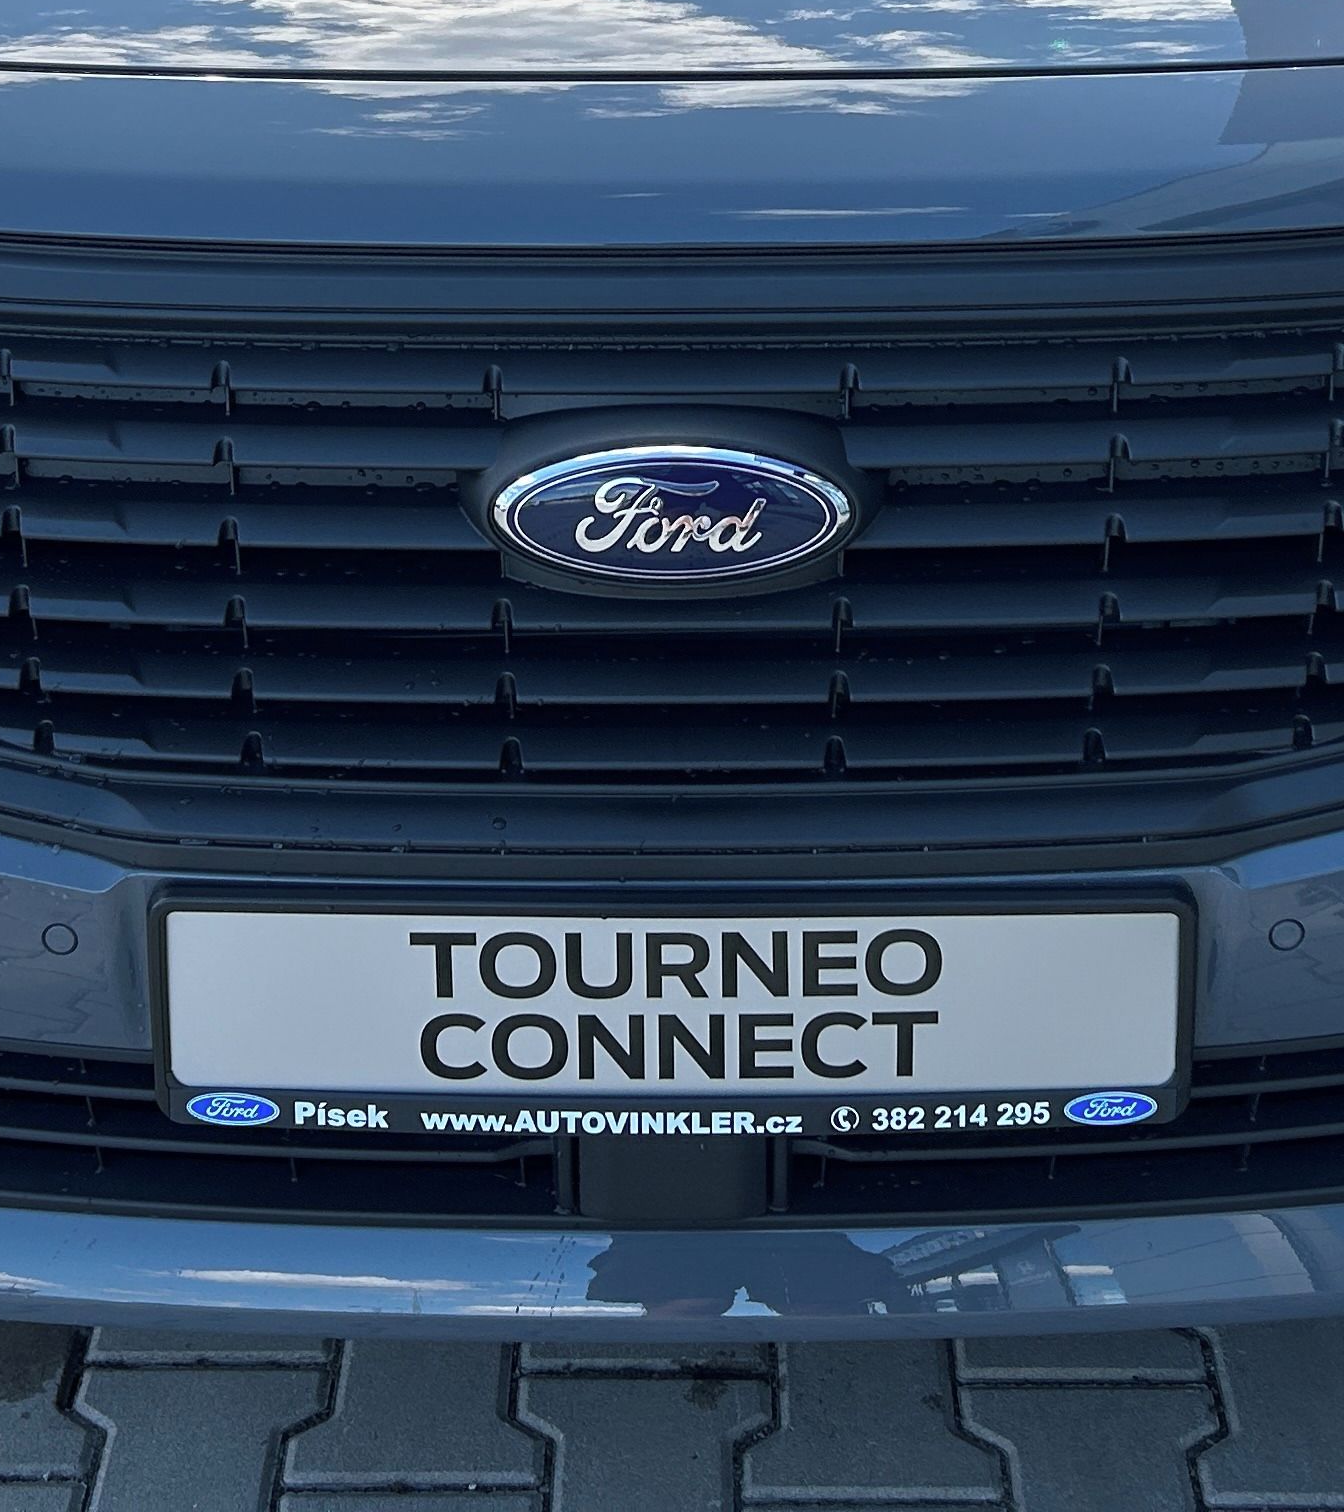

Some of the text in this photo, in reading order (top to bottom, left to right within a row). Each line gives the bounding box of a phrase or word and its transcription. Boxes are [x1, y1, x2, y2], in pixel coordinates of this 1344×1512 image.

[575, 476, 767, 553] Ford
[409, 928, 943, 999] TOURNEO
[419, 1010, 939, 1080] CONNECT
[206, 1097, 258, 1119] Ford
[294, 1101, 1051, 1135] Písek www.AUTOVINKLER.cz 382 214 295
[1084, 1097, 1136, 1118] Ford
